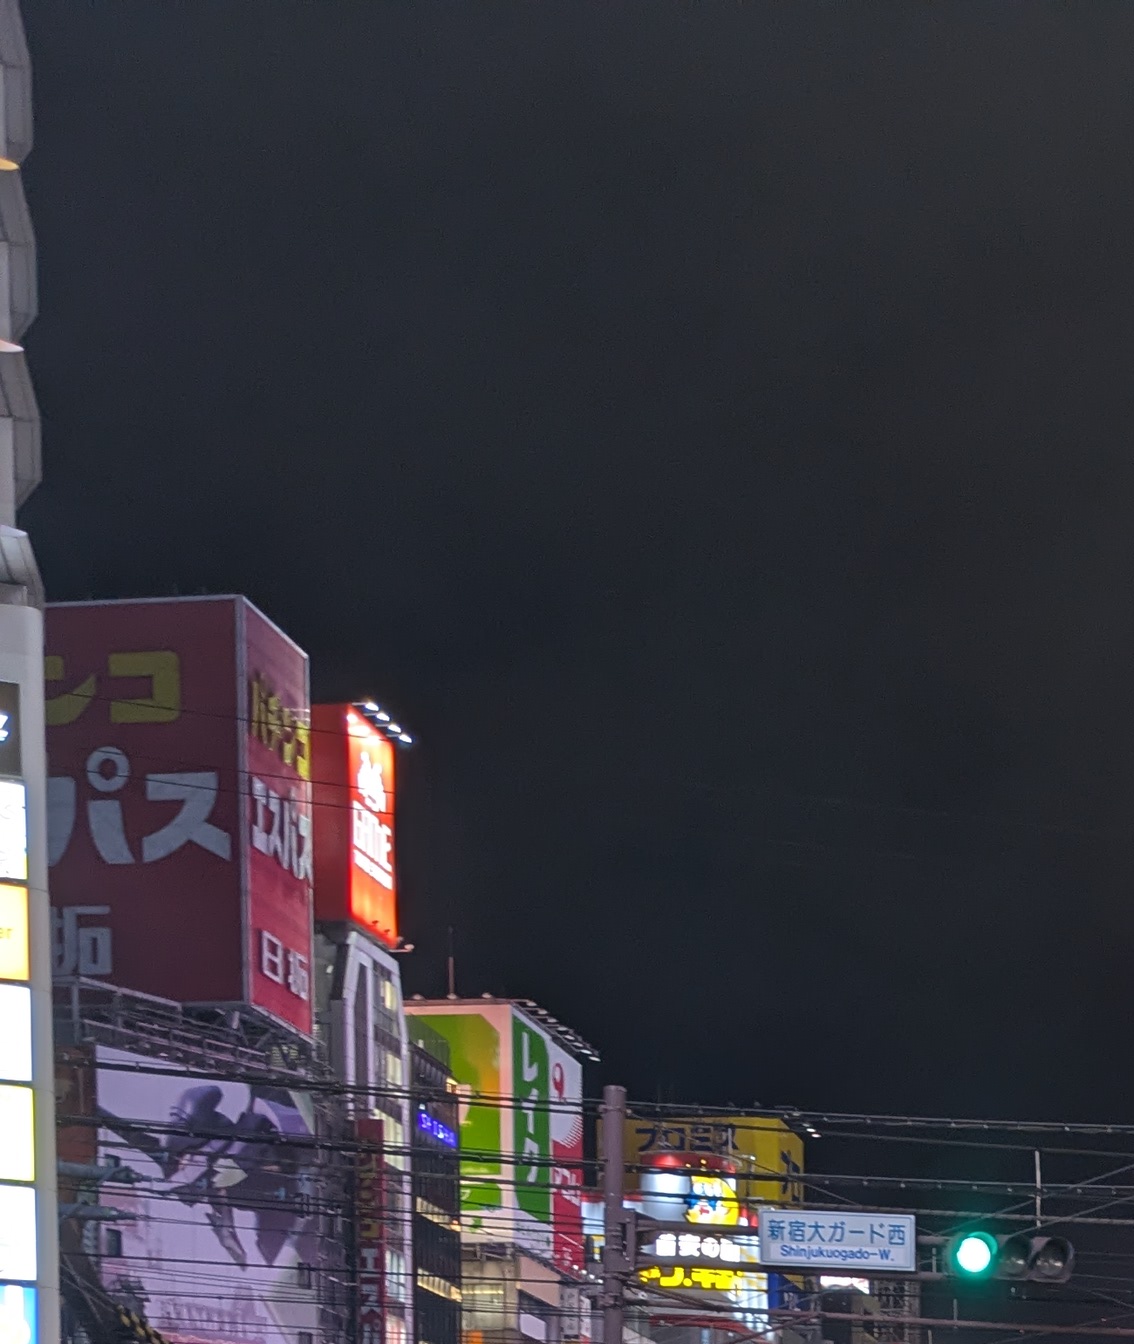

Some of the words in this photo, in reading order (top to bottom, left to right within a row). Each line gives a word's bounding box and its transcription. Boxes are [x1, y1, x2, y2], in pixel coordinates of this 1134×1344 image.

[768, 1219, 906, 1246] 新宿大ガード西
